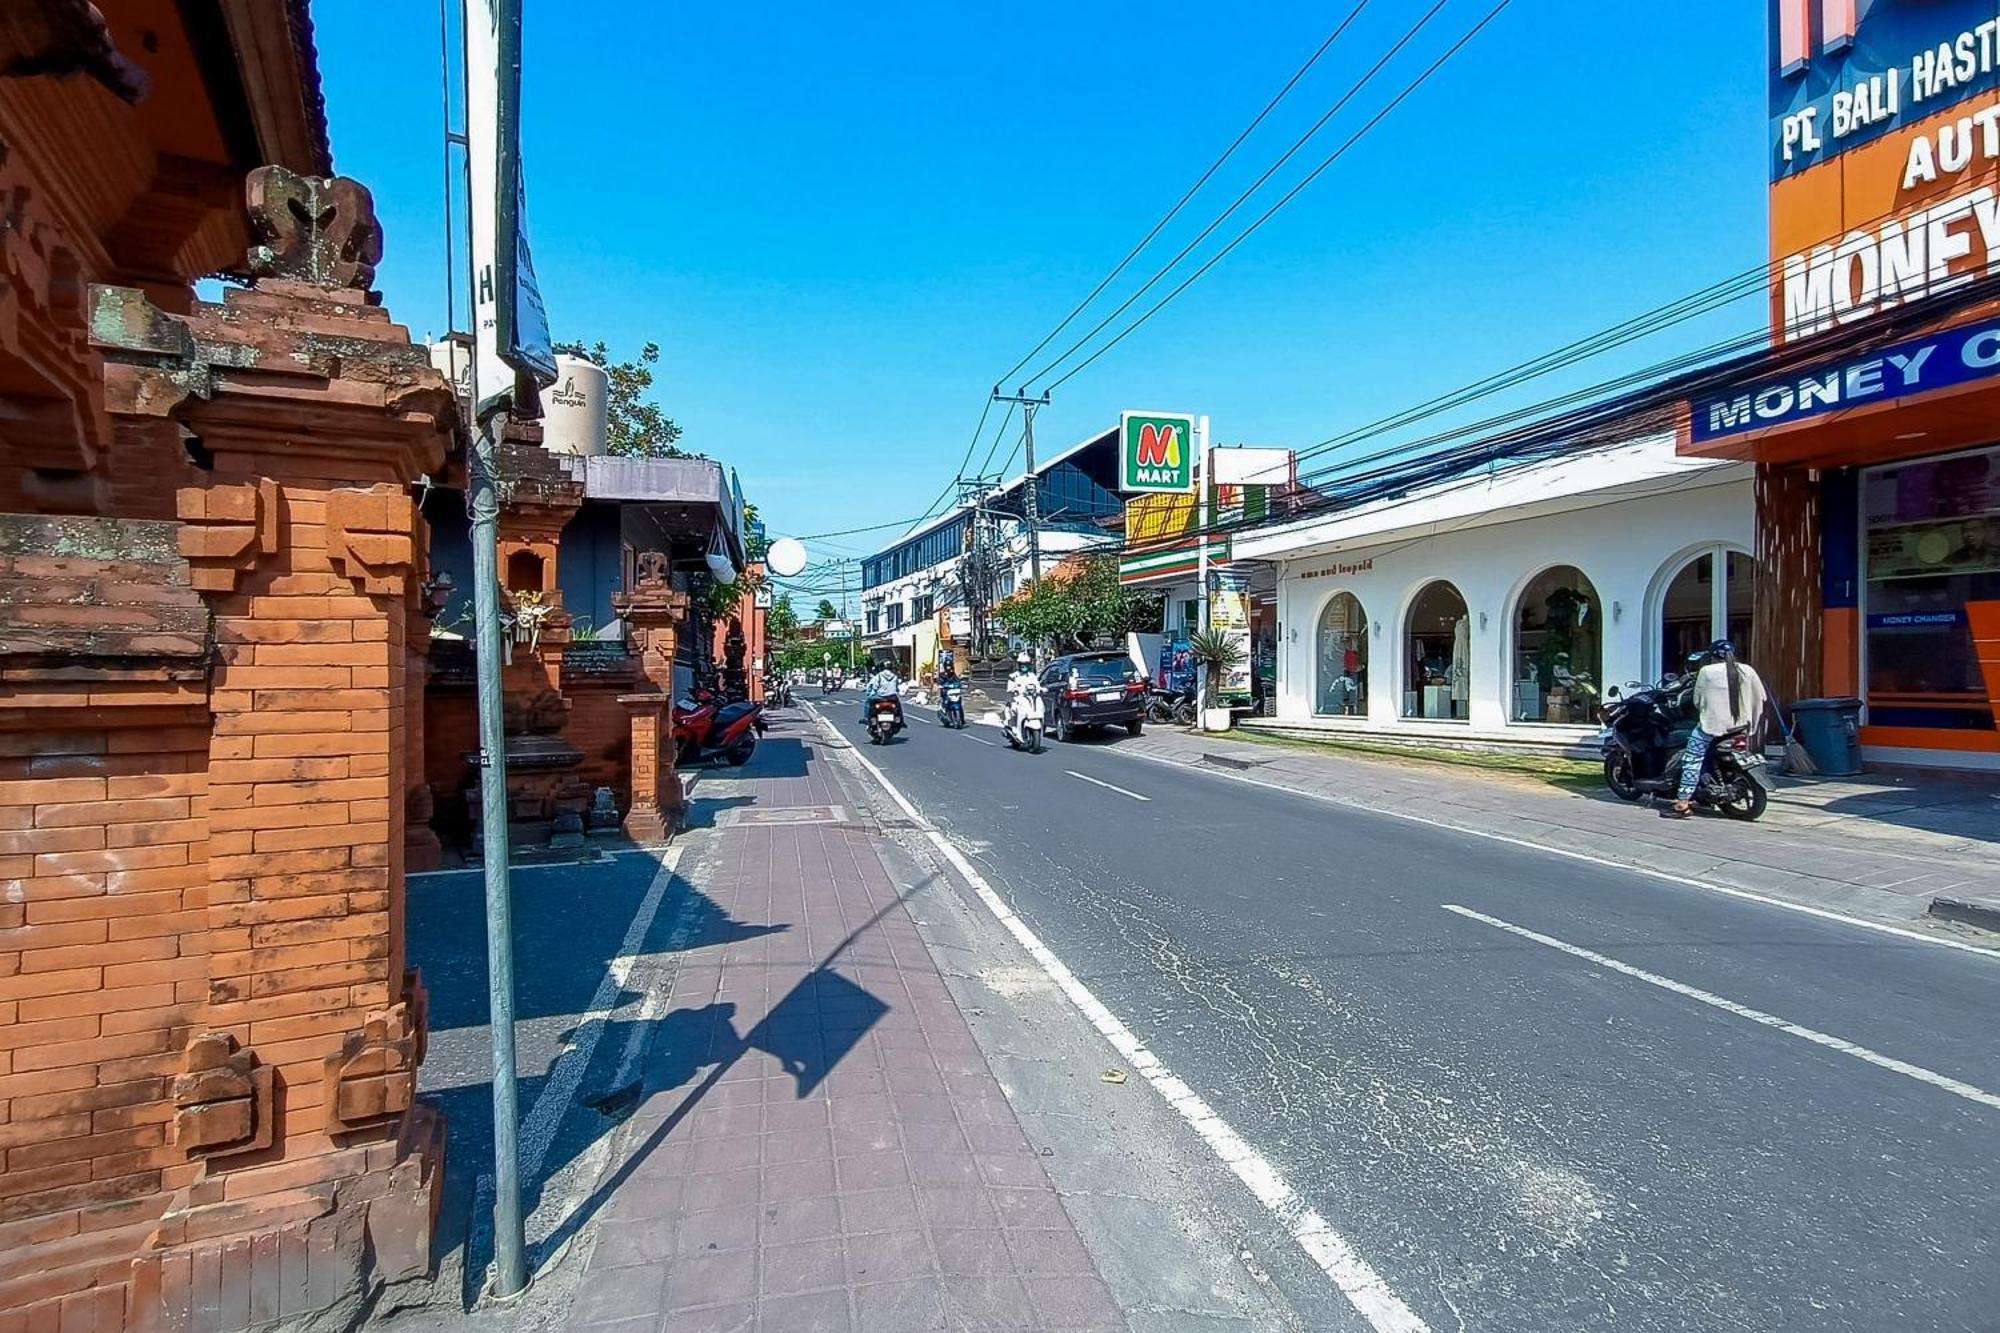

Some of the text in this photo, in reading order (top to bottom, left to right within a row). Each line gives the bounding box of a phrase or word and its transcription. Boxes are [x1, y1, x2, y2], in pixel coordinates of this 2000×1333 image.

[1833, 68, 1898, 138] BALI
[1710, 344, 1938, 432] MONEY
[552, 396, 586, 407] Penguin
[1136, 468, 1180, 484] MART
[1321, 564, 1337, 577] and
[1339, 559, 1373, 575] leopold
[1882, 614, 1956, 625] MONEY CHANGER
